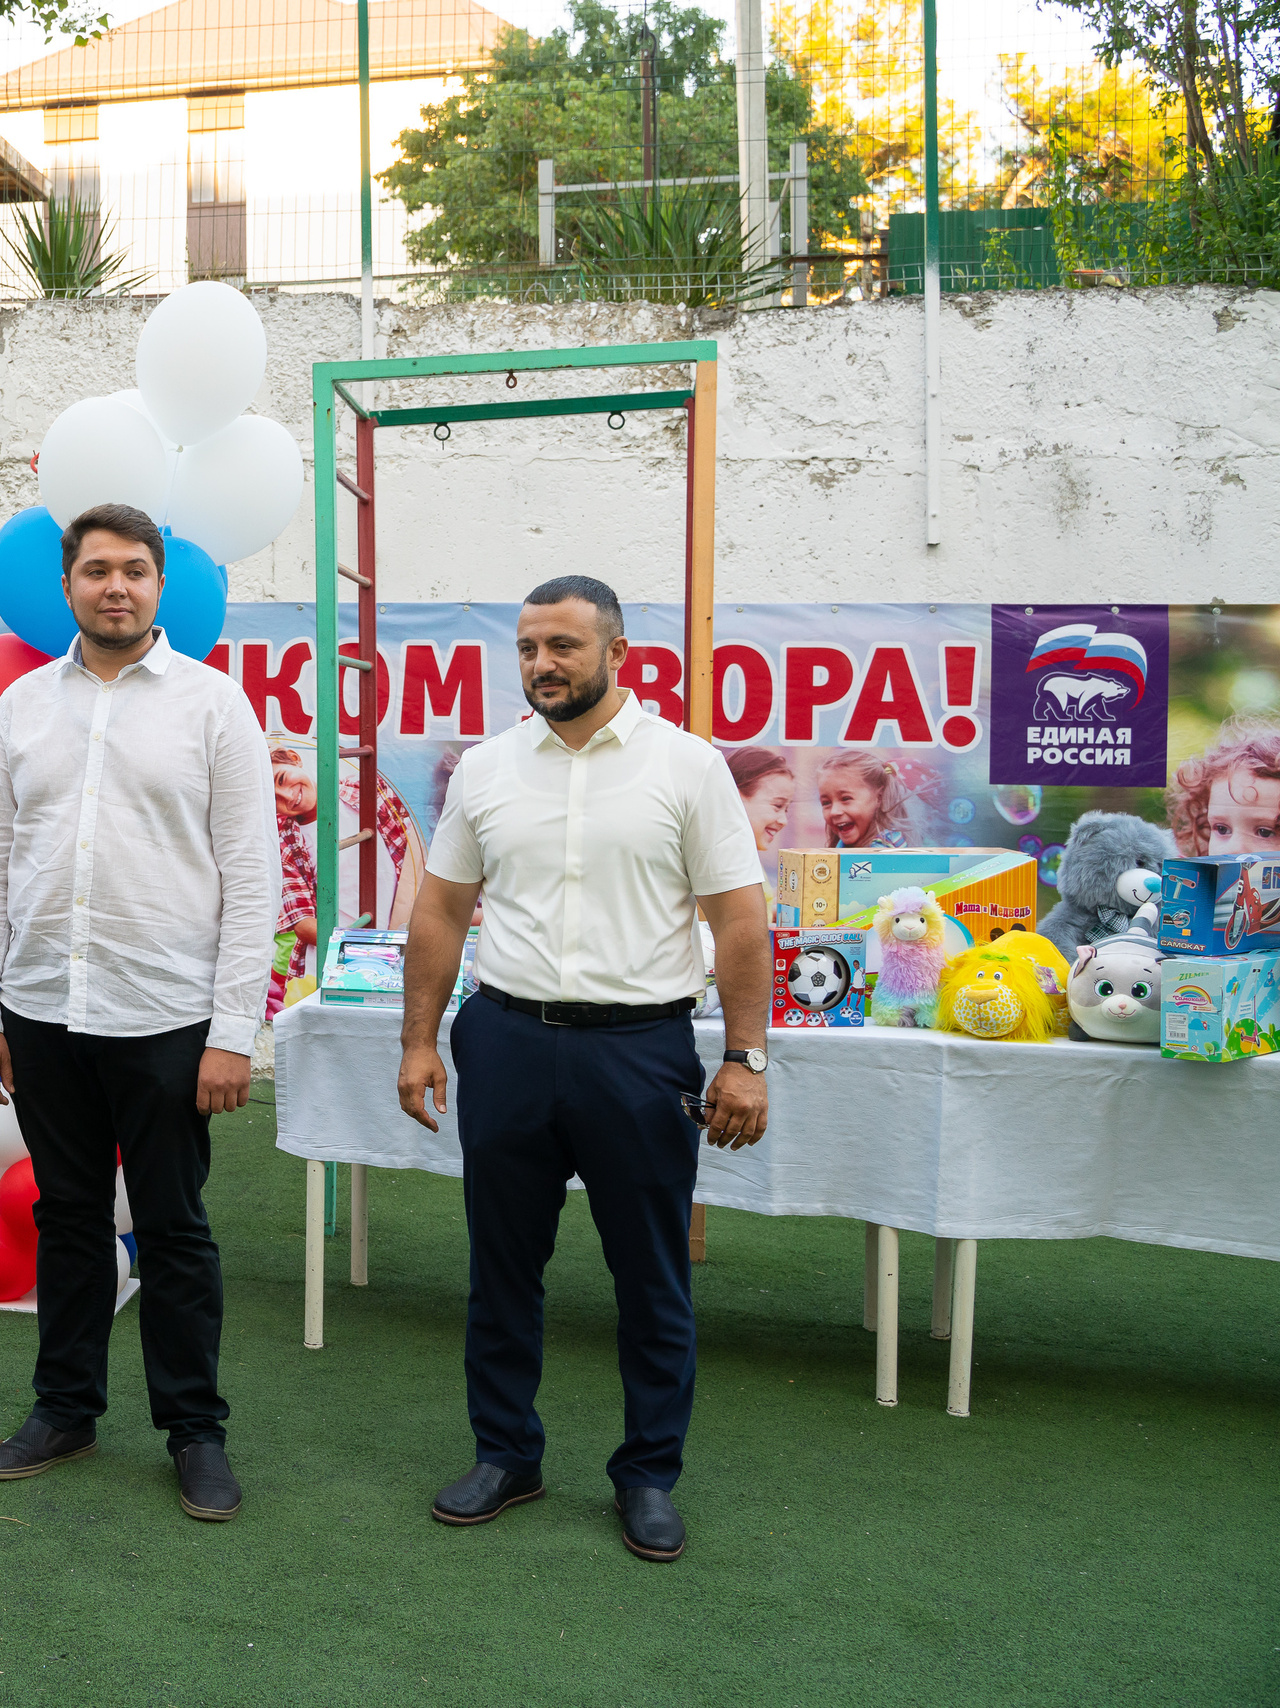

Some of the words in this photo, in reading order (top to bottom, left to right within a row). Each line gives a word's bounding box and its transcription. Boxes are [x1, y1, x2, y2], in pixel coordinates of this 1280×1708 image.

[1026, 726, 1132, 746] ЕДИНАЯ
[1026, 747, 1131, 766] РОССИЯ
[955, 901, 981, 917] Маша
[989, 903, 1032, 918] Медведь
[779, 938, 795, 949] THE
[795, 935, 819, 946] MAGIC
[821, 933, 842, 943] GLIDE
[843, 932, 862, 942] BALL
[1160, 940, 1207, 952] САМОКАТ
